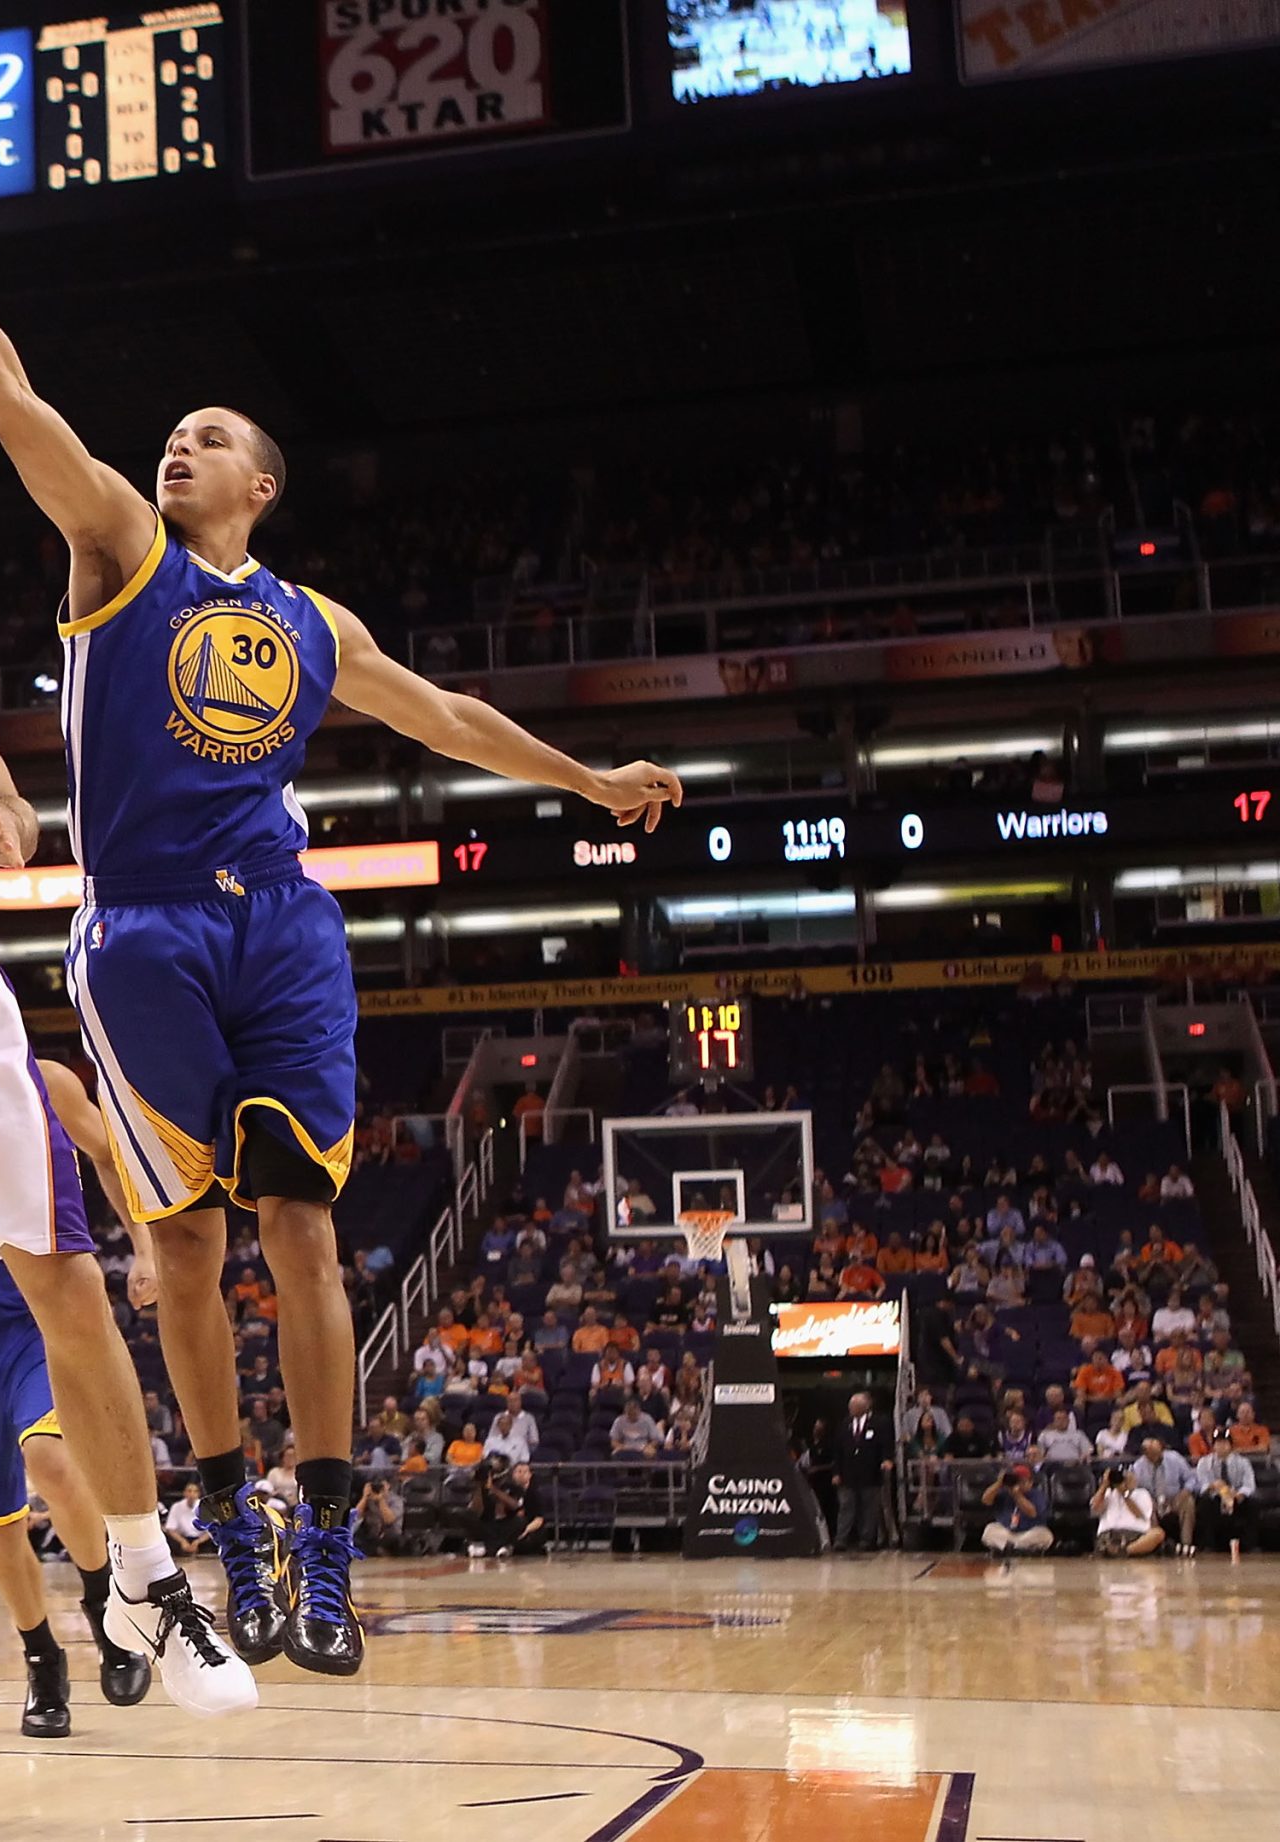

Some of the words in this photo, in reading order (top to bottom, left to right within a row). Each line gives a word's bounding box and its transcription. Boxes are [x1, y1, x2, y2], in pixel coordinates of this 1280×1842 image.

[328, 4, 541, 110] 620
[362, 93, 505, 138] KTAR
[170, 598, 242, 629] GOLDEN
[251, 601, 302, 643] STATE
[231, 634, 277, 669] 30
[164, 710, 296, 765] WARRIORS
[1234, 791, 1271, 822] 17
[901, 814, 923, 849] 0
[997, 808, 1108, 840] Warriors
[454, 842, 488, 872] 17
[573, 840, 637, 866] Suns
[709, 826, 731, 861] 0
[850, 965, 893, 986] 108
[489, 985, 549, 1004] Identity
[554, 982, 595, 998] Theft
[601, 980, 689, 997] Protection
[687, 1003, 741, 1034] 11:10
[698, 1029, 736, 1069] 17
[708, 1474, 783, 1496] CASINO
[700, 1494, 792, 1515] ARIZONA
